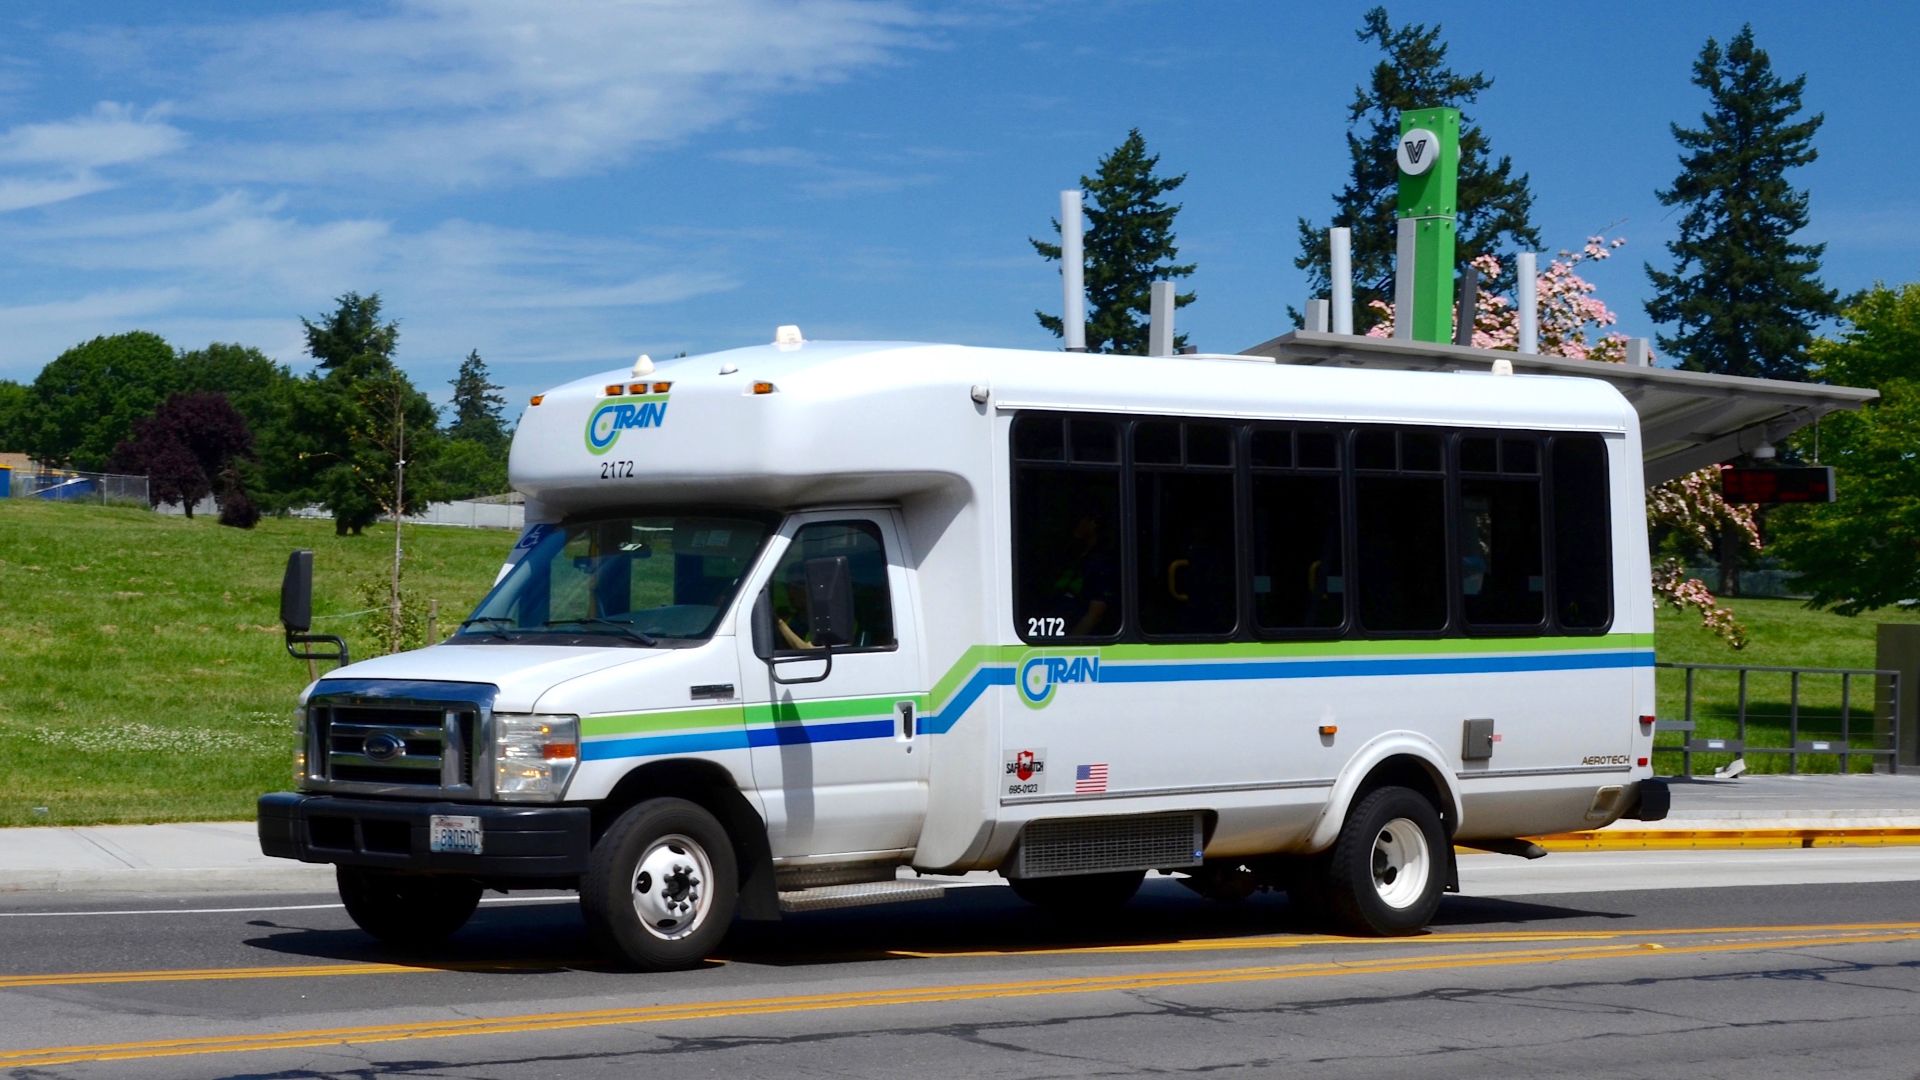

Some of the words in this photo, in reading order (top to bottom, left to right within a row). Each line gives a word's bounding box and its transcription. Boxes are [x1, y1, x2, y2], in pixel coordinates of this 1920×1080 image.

[1405, 139, 1427, 164] V
[600, 460, 634, 480] 2172
[1028, 617, 1065, 636] 2172
[1581, 755, 1630, 766] AEROTECH
[1009, 784, 1038, 794] 695-0123
